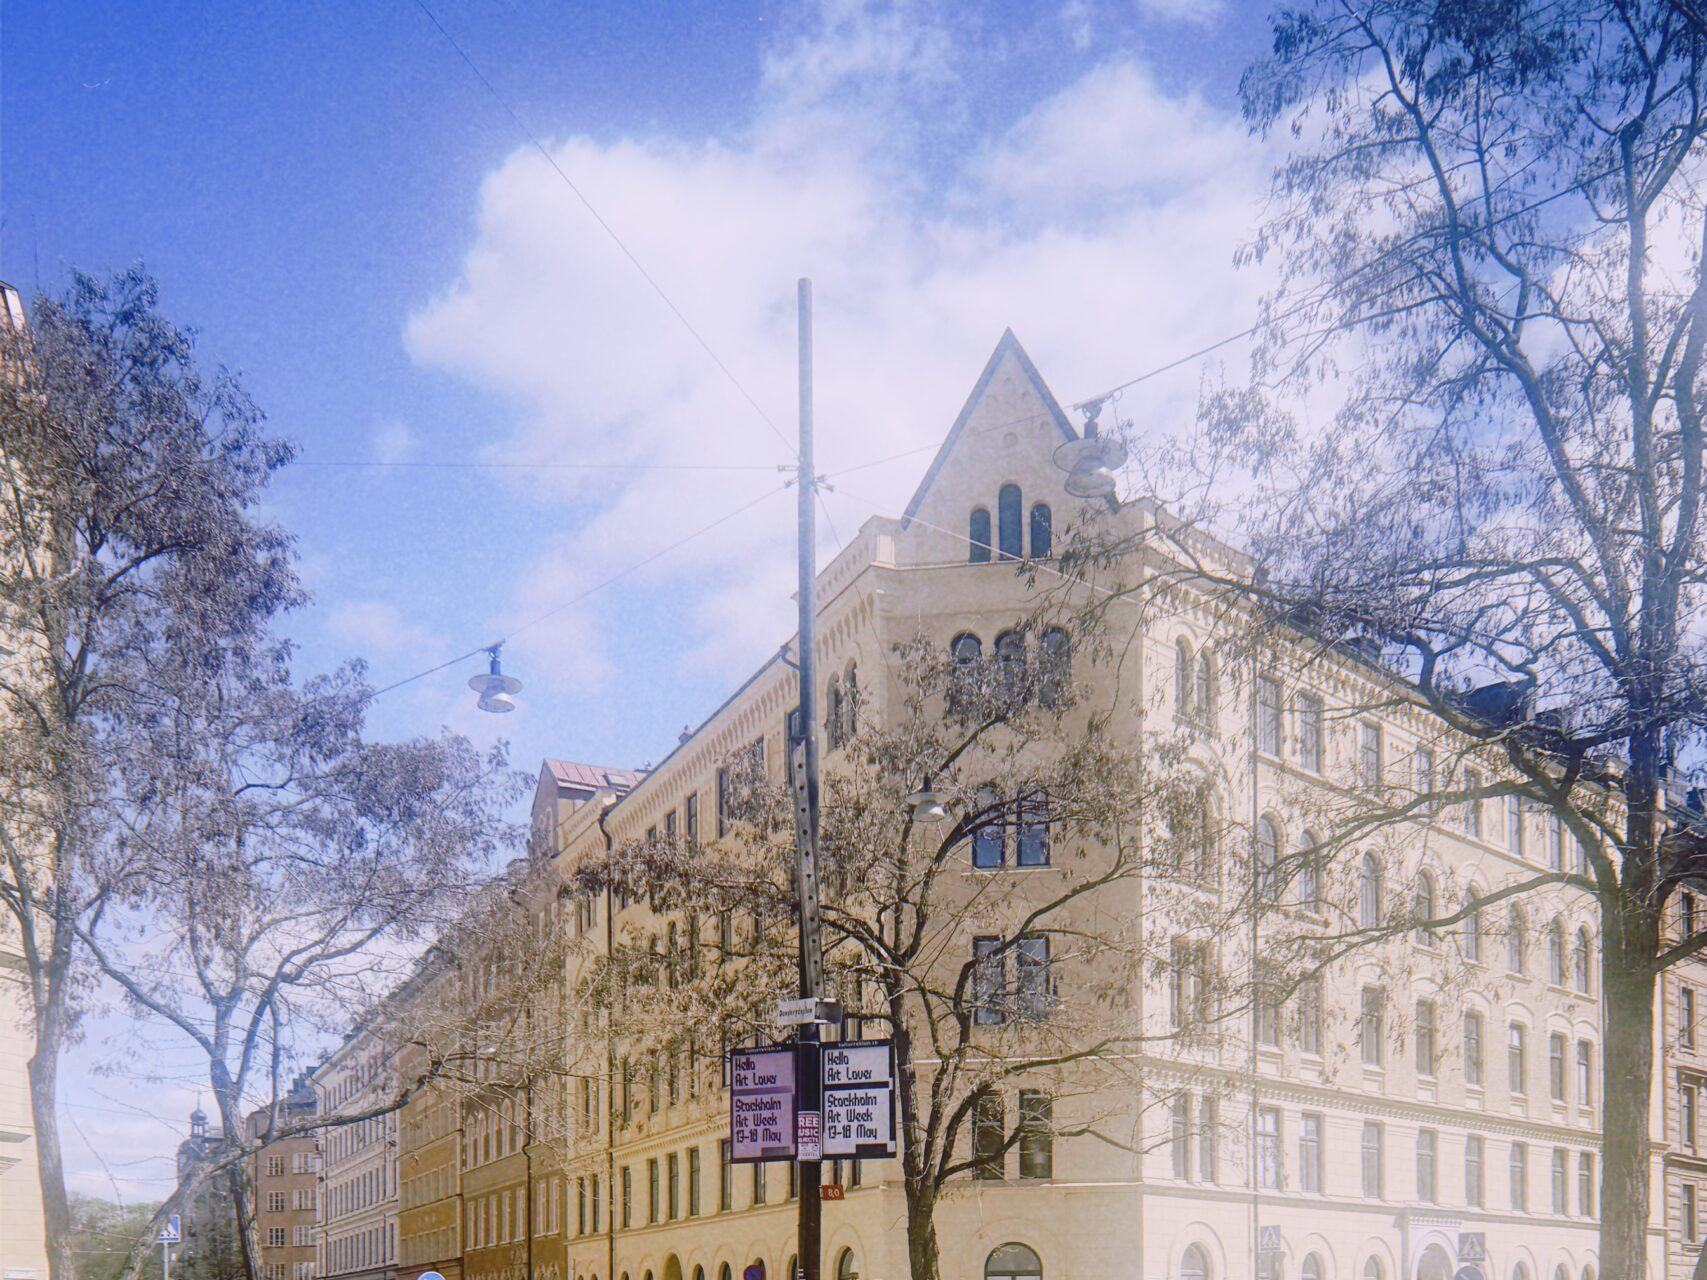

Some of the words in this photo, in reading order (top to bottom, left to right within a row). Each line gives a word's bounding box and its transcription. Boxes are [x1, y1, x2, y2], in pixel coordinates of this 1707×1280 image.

[735, 1057, 755, 1071] Hello
[827, 1051, 849, 1065] Hello
[735, 1073, 748, 1087] Art
[753, 1072, 777, 1086] Lover
[827, 1067, 841, 1081] Art
[847, 1066, 872, 1080] Lover
[735, 1096, 781, 1112] Stockholm
[827, 1092, 877, 1107] Stockholm
[735, 1114, 749, 1128] Art
[753, 1112, 777, 1126] Week
[798, 1117, 819, 1128] REE
[827, 1109, 841, 1123] Art
[847, 1108, 872, 1122] Week
[762, 1128, 781, 1143] May
[798, 1128, 819, 1137] USIC
[856, 1123, 877, 1140] May
